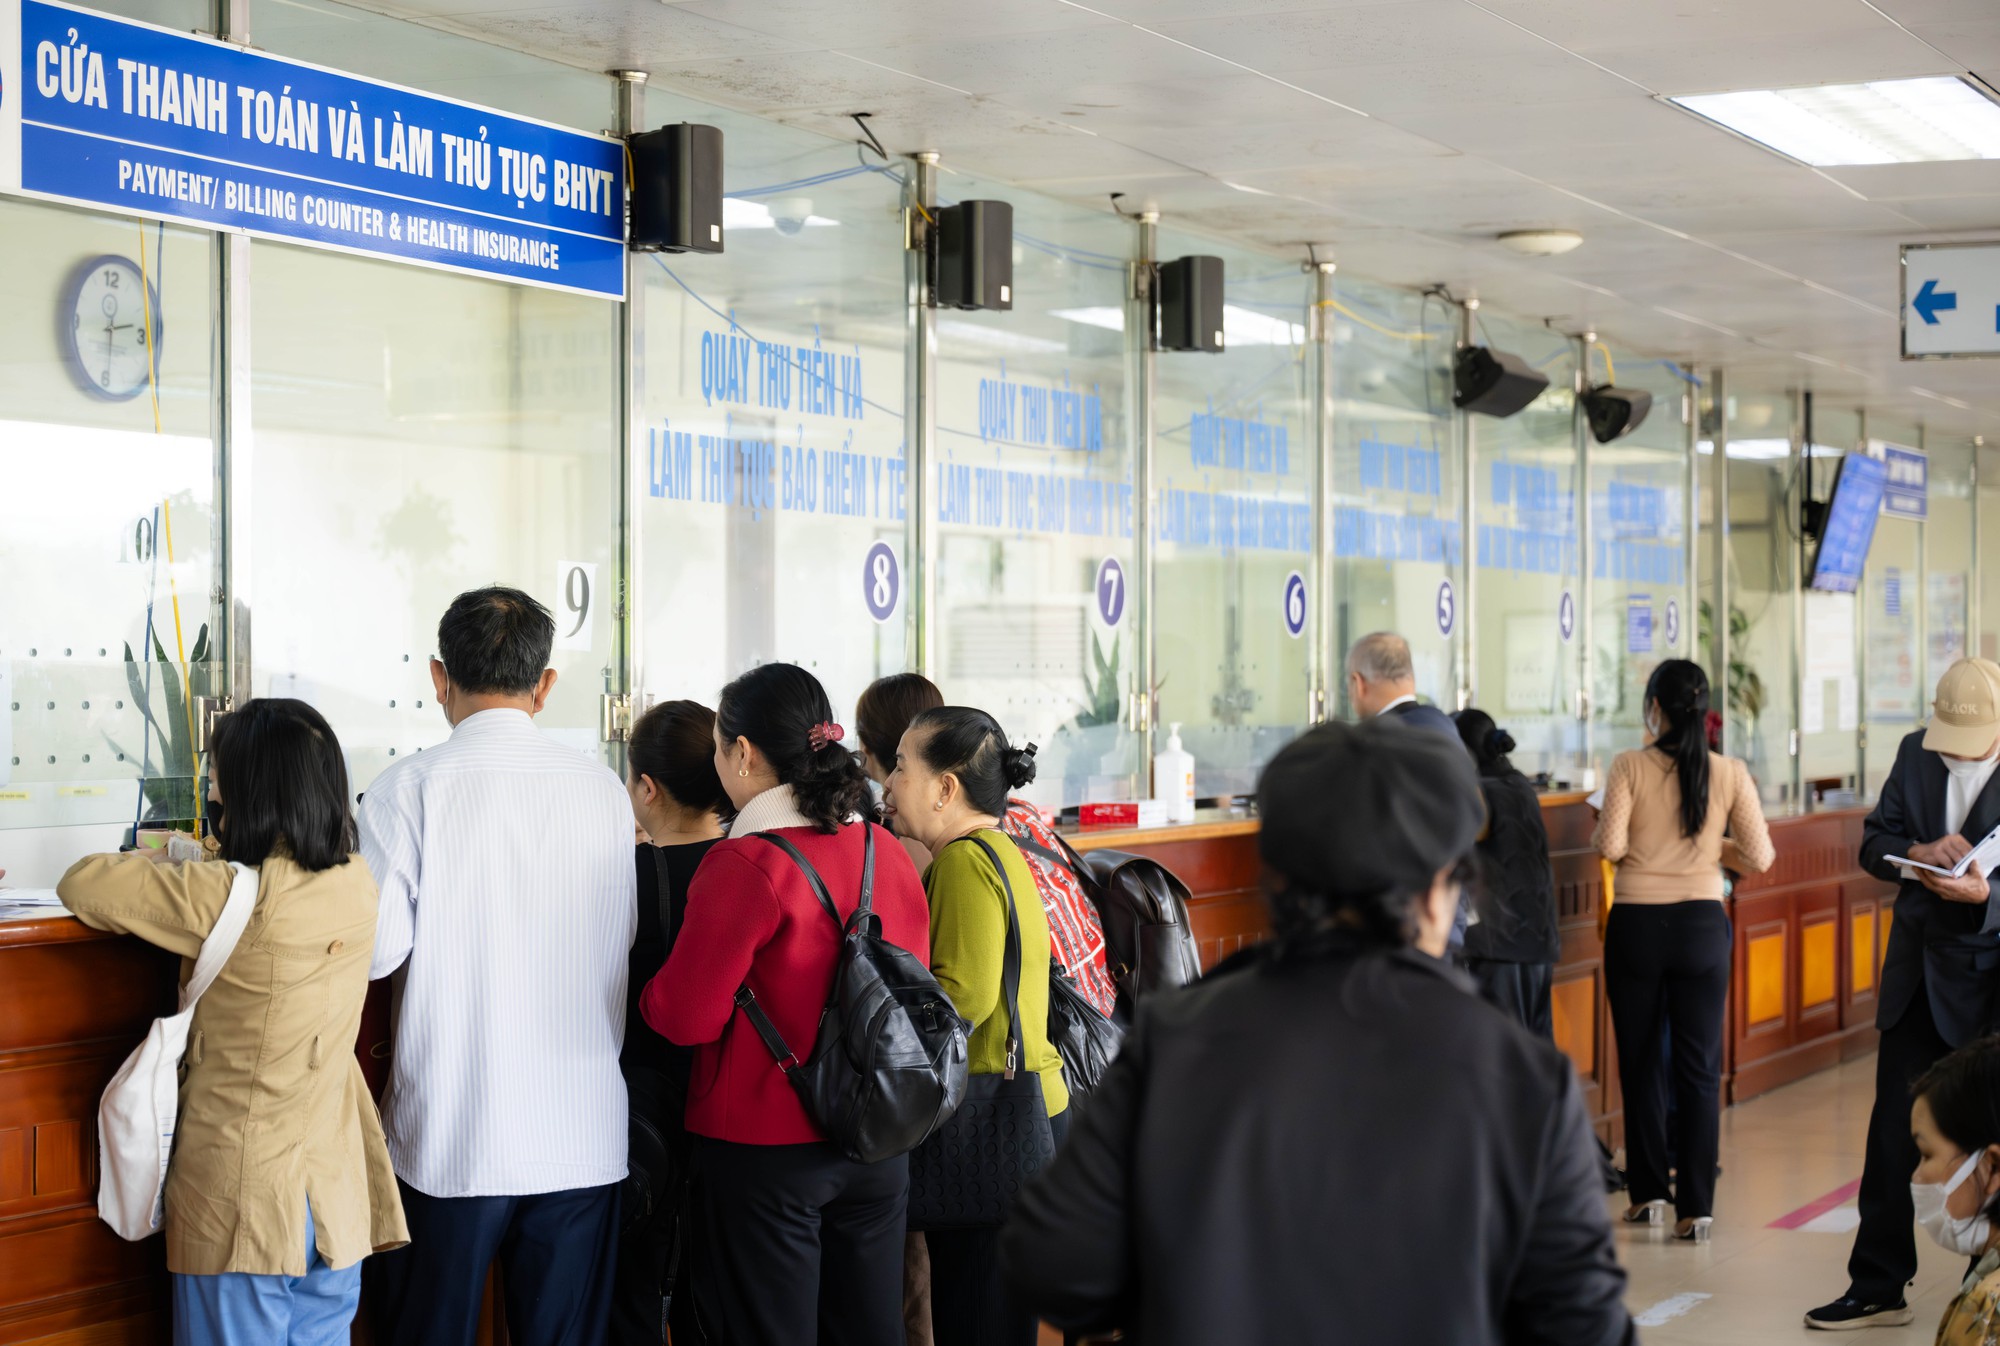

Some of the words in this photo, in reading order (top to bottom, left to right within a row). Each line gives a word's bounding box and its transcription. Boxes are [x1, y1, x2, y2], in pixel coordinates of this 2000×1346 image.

[36, 27, 108, 109] CỬA
[117, 58, 228, 134] THANH
[237, 85, 319, 154] TOÁN
[327, 101, 366, 164] VÀ
[374, 110, 433, 179] LÀM
[441, 125, 491, 190] THỦ
[498, 146, 546, 209] TỤC
[554, 160, 614, 216] BHYT
[118, 159, 219, 210] PAYMENT/
[225, 180, 297, 221] BILLING
[302, 195, 383, 237] COUNTER
[389, 212, 402, 241] &
[407, 216, 468, 254] HEALTH
[473, 228, 559, 271] INSURANCE
[104, 270, 119, 288] 12
[137, 328, 145, 345] 3
[101, 371, 110, 387] 6
[701, 308, 750, 407] QUẦY
[757, 341, 791, 410] THU
[797, 324, 835, 416] TIỀN
[841, 344, 863, 420] VÀ
[1021, 385, 1047, 445] THU
[650, 417, 692, 500] LÀM
[699, 412, 736, 505] THỦ
[740, 440, 775, 522] TỤC
[782, 423, 817, 513] BẢO
[823, 428, 866, 517] HIỂM
[872, 456, 881, 518] Y
[938, 448, 970, 525] LÀM
[116, 517, 152, 564] 10
[565, 566, 590, 638] 9
[873, 553, 891, 608] 8
[1104, 568, 1119, 616] 7
[1289, 582, 1302, 625] 6
[1440, 587, 1451, 627] 5
[1562, 598, 1571, 632] 4
